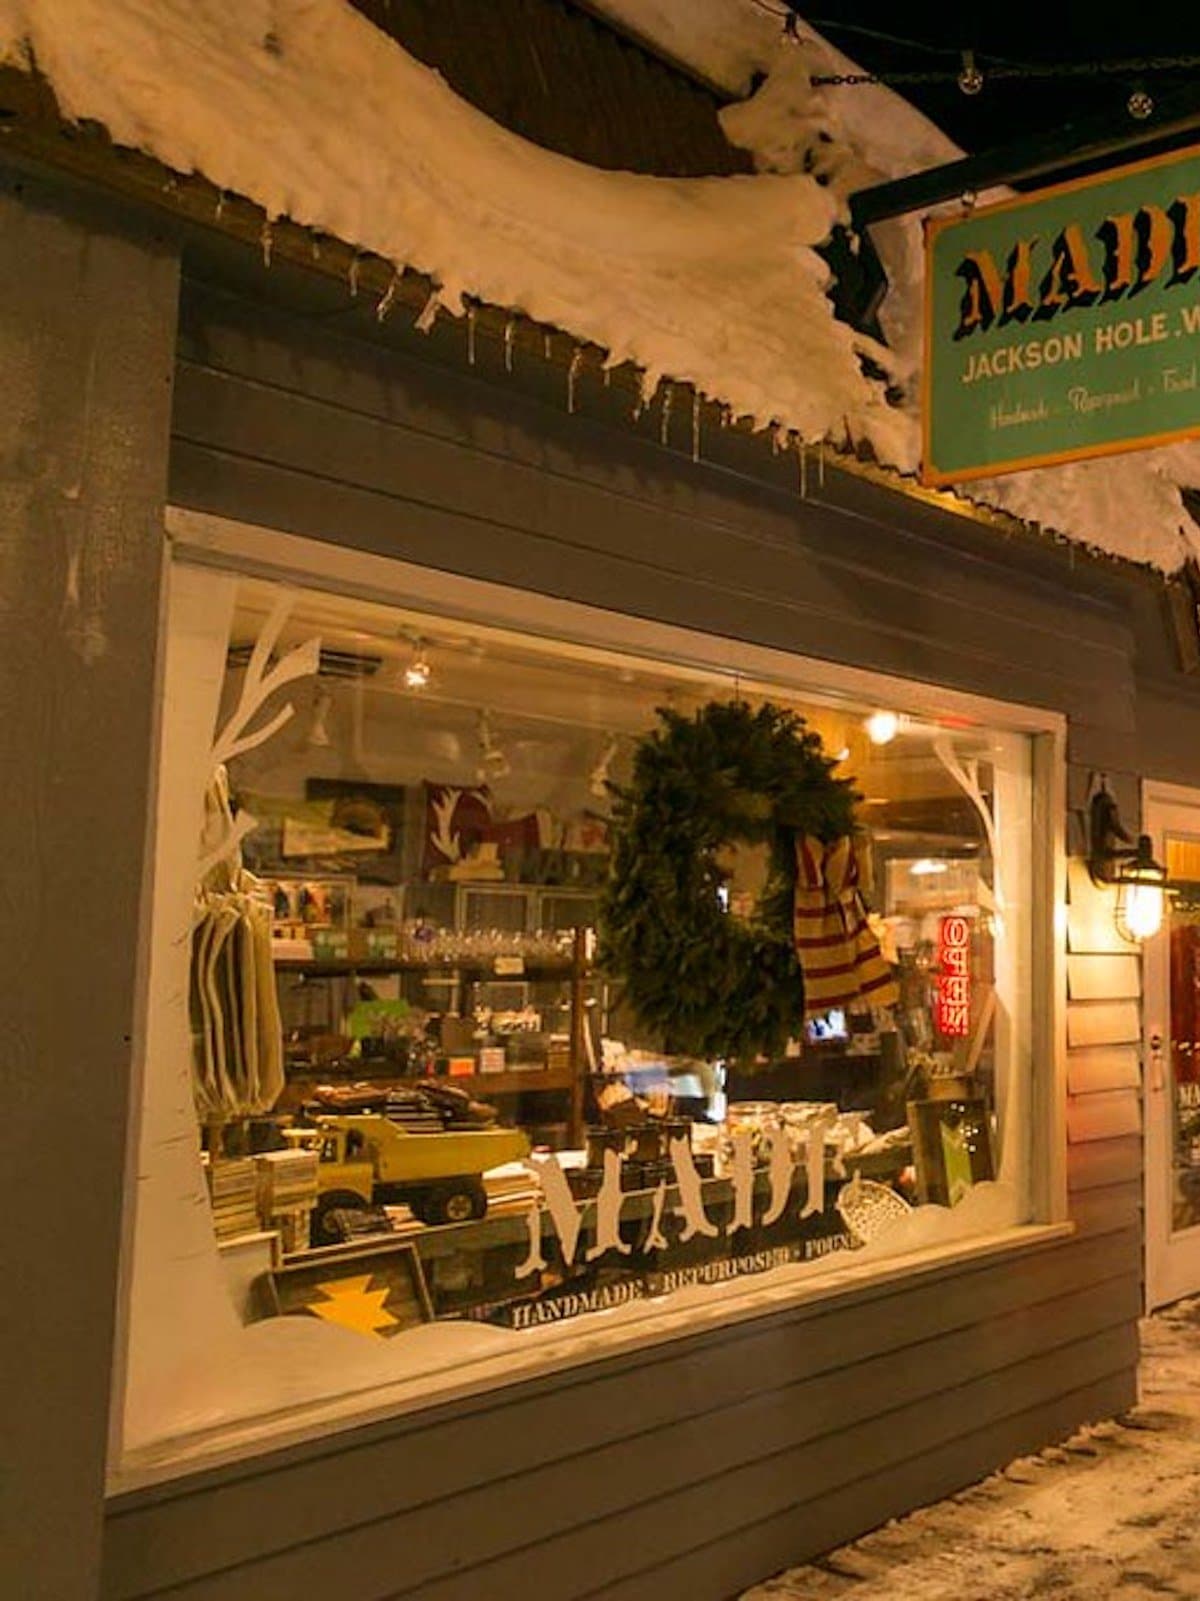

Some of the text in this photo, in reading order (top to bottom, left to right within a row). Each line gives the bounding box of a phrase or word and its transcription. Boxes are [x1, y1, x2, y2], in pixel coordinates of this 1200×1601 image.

[961, 333, 1082, 383] JACKSON
[513, 1279, 643, 1329] HANDMADE
[663, 1246, 790, 1293] REPURPOSED
